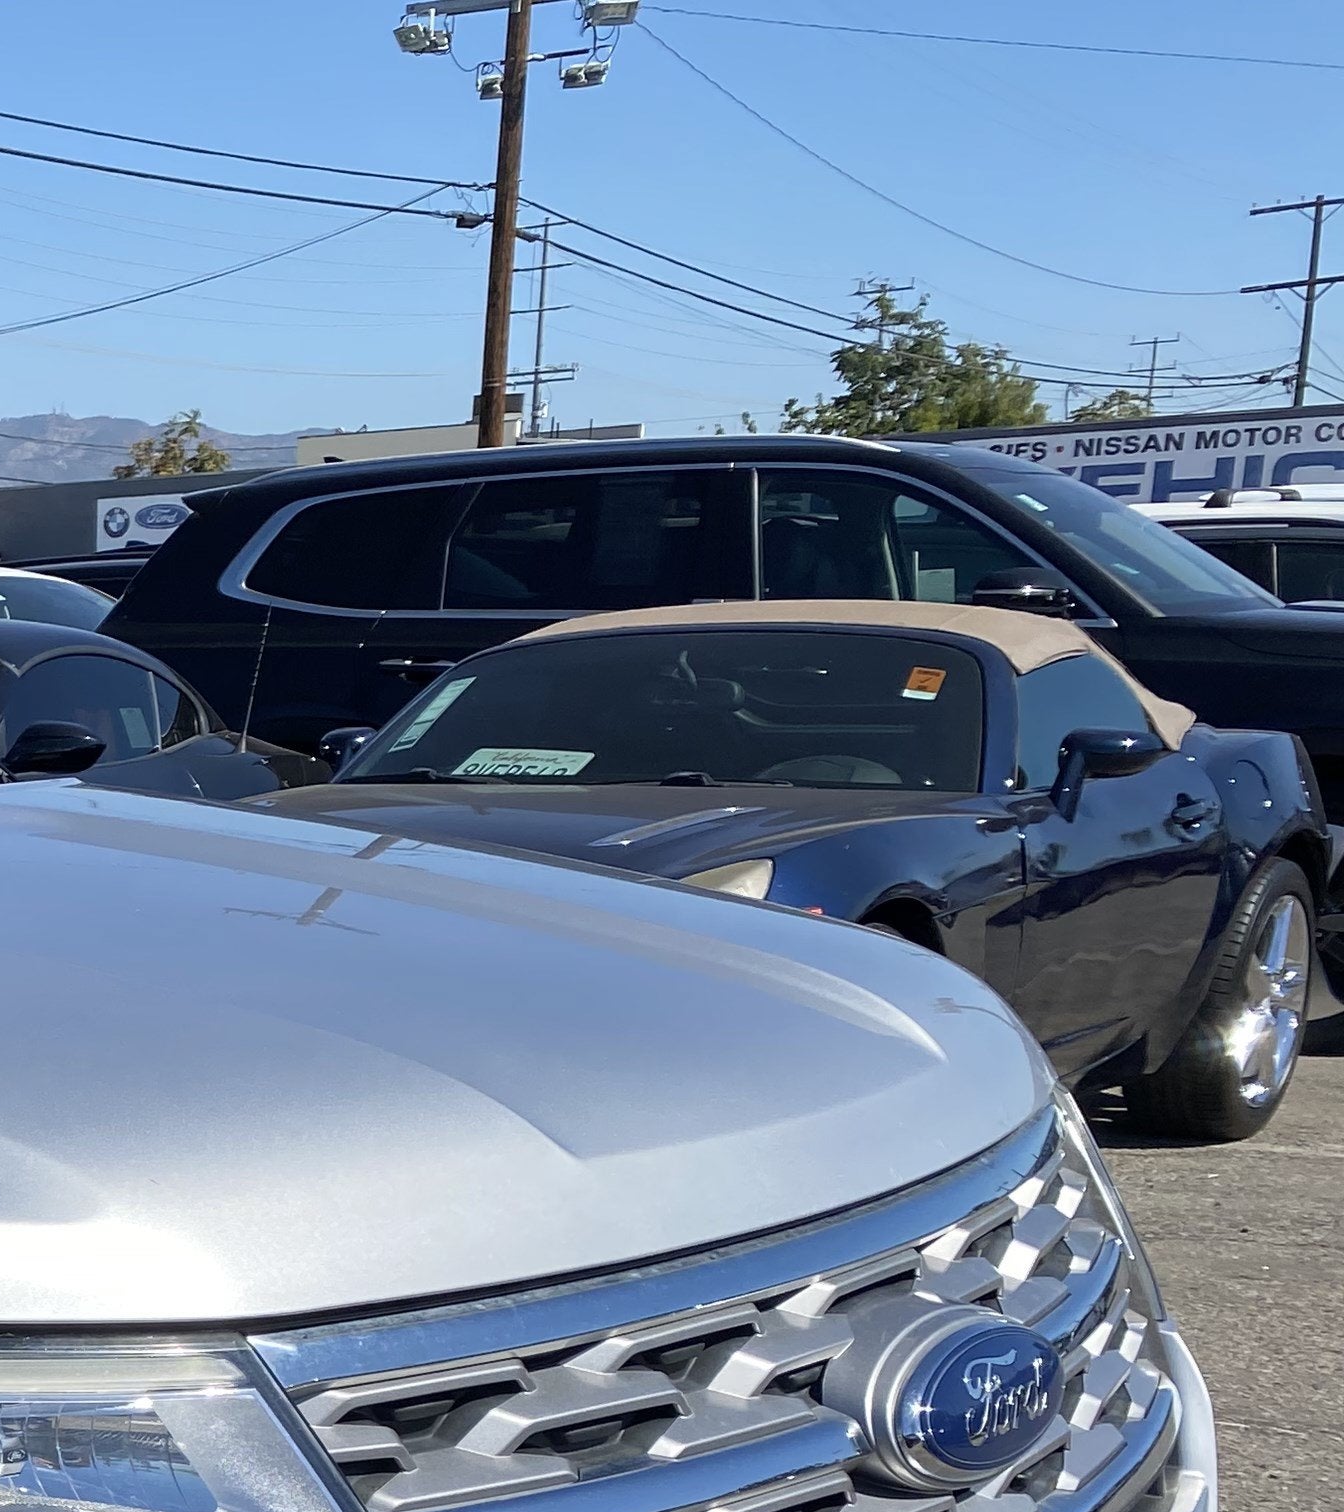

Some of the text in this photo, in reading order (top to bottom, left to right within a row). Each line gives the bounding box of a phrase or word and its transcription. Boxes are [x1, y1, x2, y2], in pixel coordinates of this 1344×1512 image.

[1073, 432, 1185, 457] NISSAN
[1195, 425, 1303, 449] MOTOR
[146, 507, 178, 523] Ford
[962, 1348, 1049, 1447] Ford
